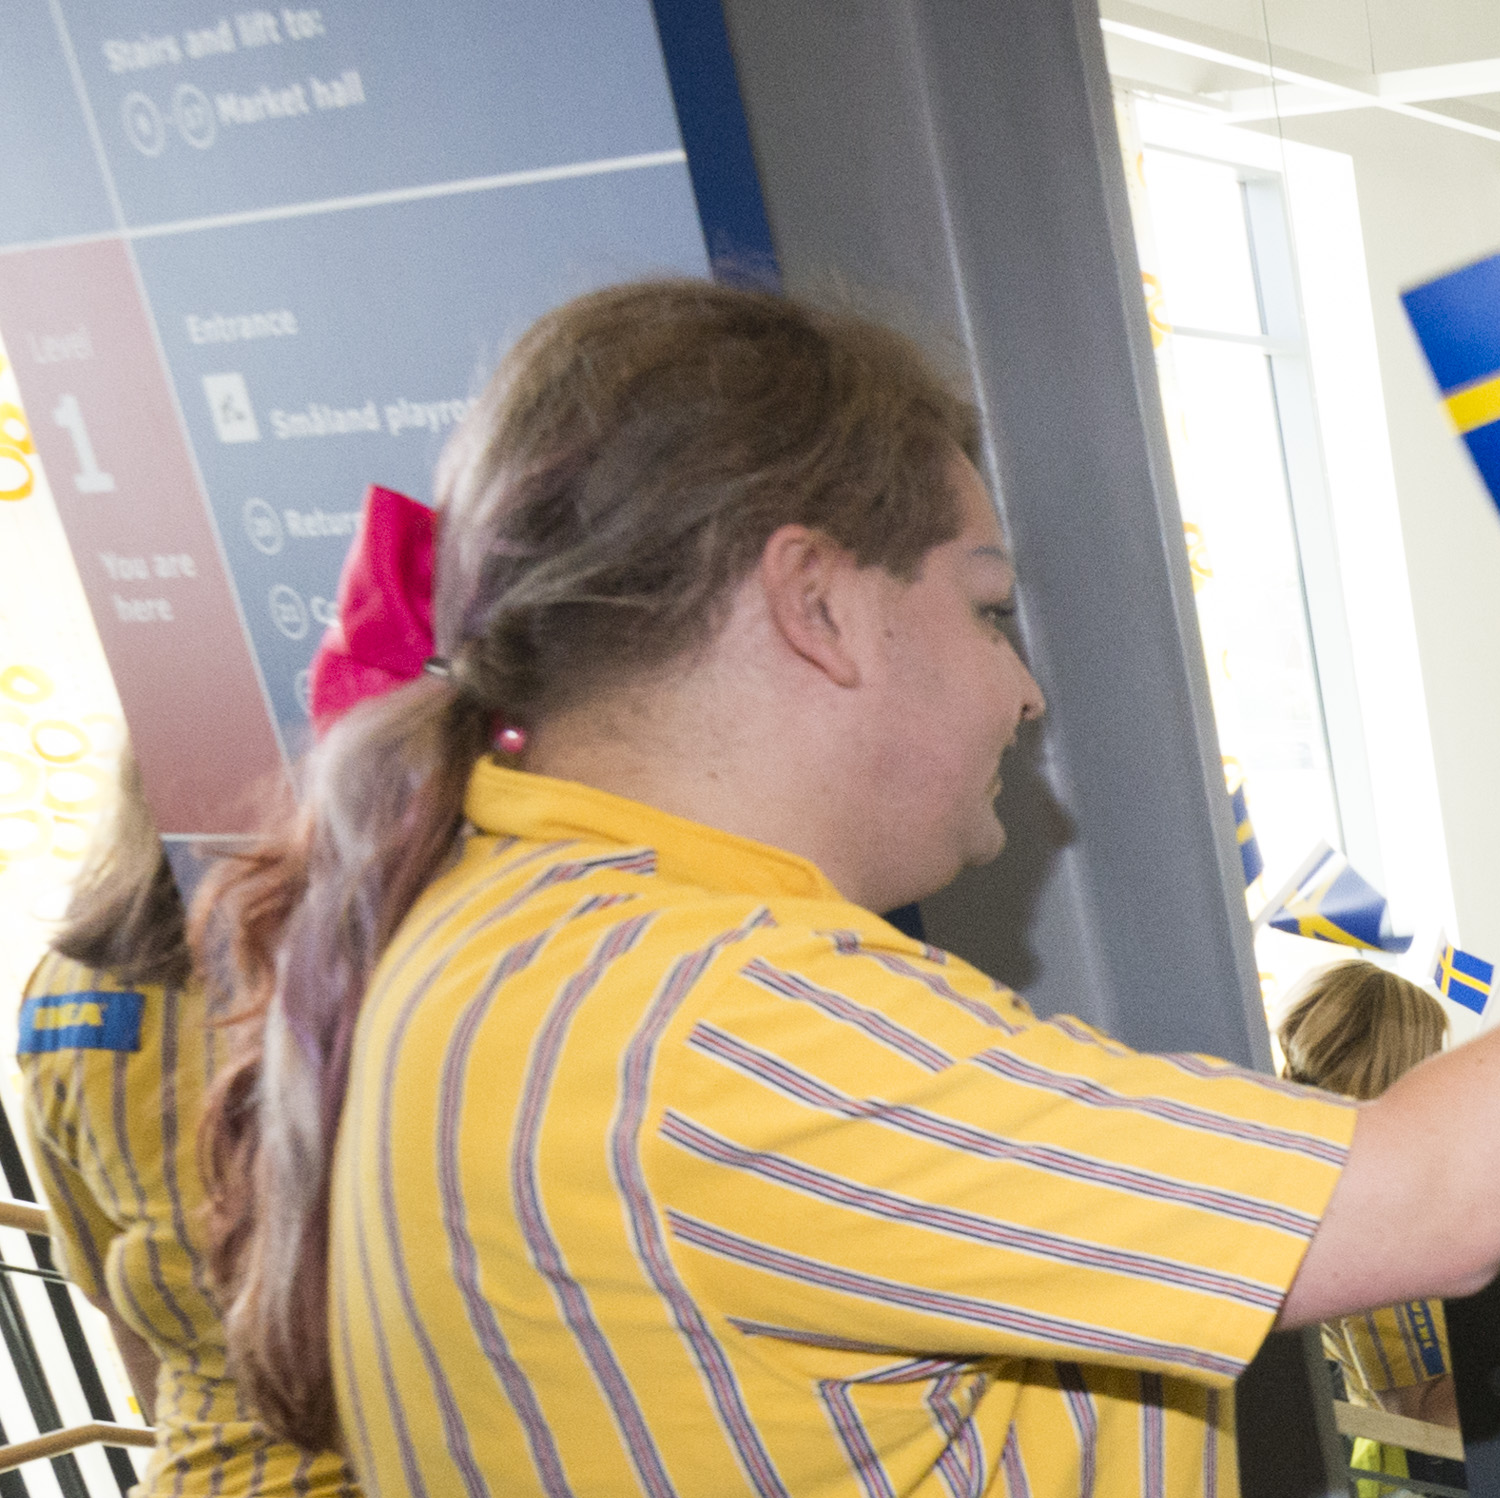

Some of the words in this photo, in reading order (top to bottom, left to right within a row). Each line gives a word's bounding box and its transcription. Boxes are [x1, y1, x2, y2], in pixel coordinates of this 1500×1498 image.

[103, 35, 181, 73] Stairs
[184, 20, 235, 59] and
[214, 83, 309, 124] Market
[309, 68, 366, 110] hall
[30, 325, 93, 364] Level
[186, 309, 298, 345] Entrance
[54, 393, 116, 493] 1
[101, 551, 149, 581] You
[153, 554, 197, 579] are
[112, 592, 175, 623] here
